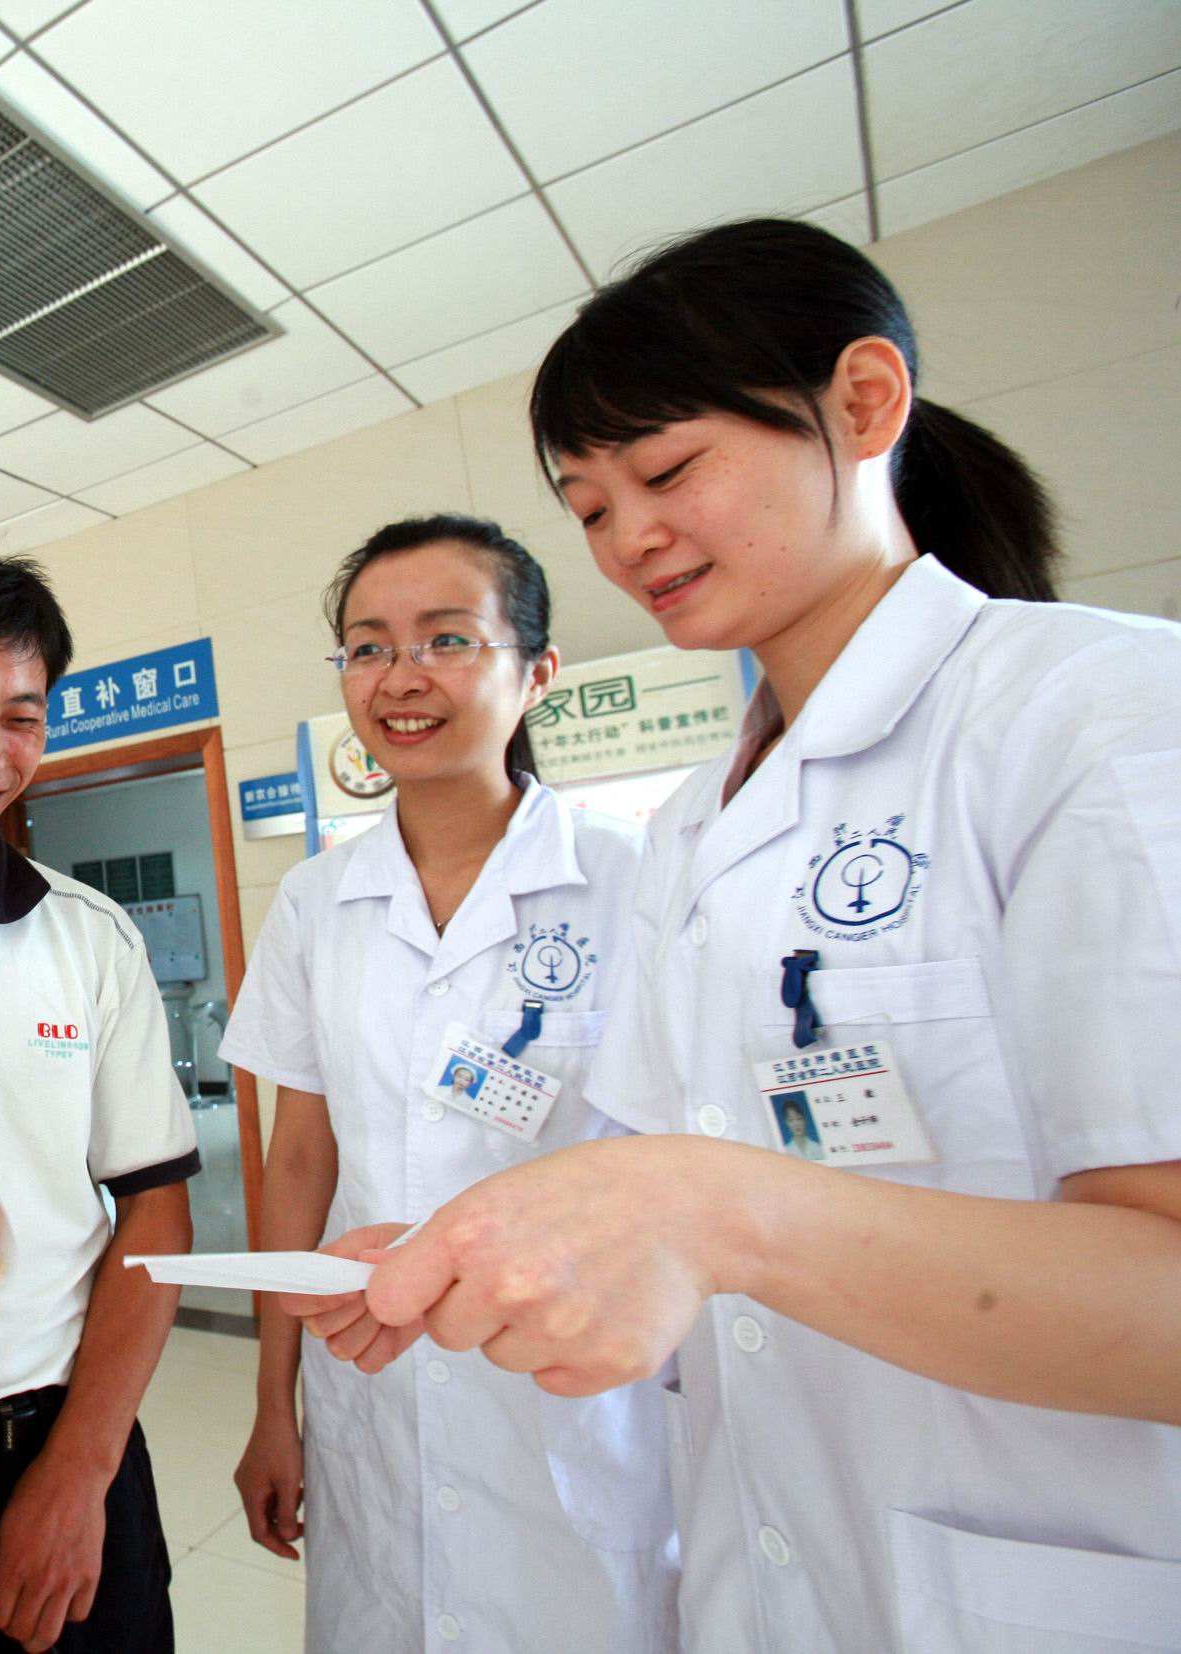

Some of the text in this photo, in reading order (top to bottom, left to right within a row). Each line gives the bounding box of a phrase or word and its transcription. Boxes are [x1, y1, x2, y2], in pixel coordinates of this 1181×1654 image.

[46, 659, 197, 719] 直补窗口
[70, 709, 130, 735] Cooperative
[131, 699, 172, 720] Medical
[173, 692, 200, 710] Care
[37, 1022, 79, 1040] BLD
